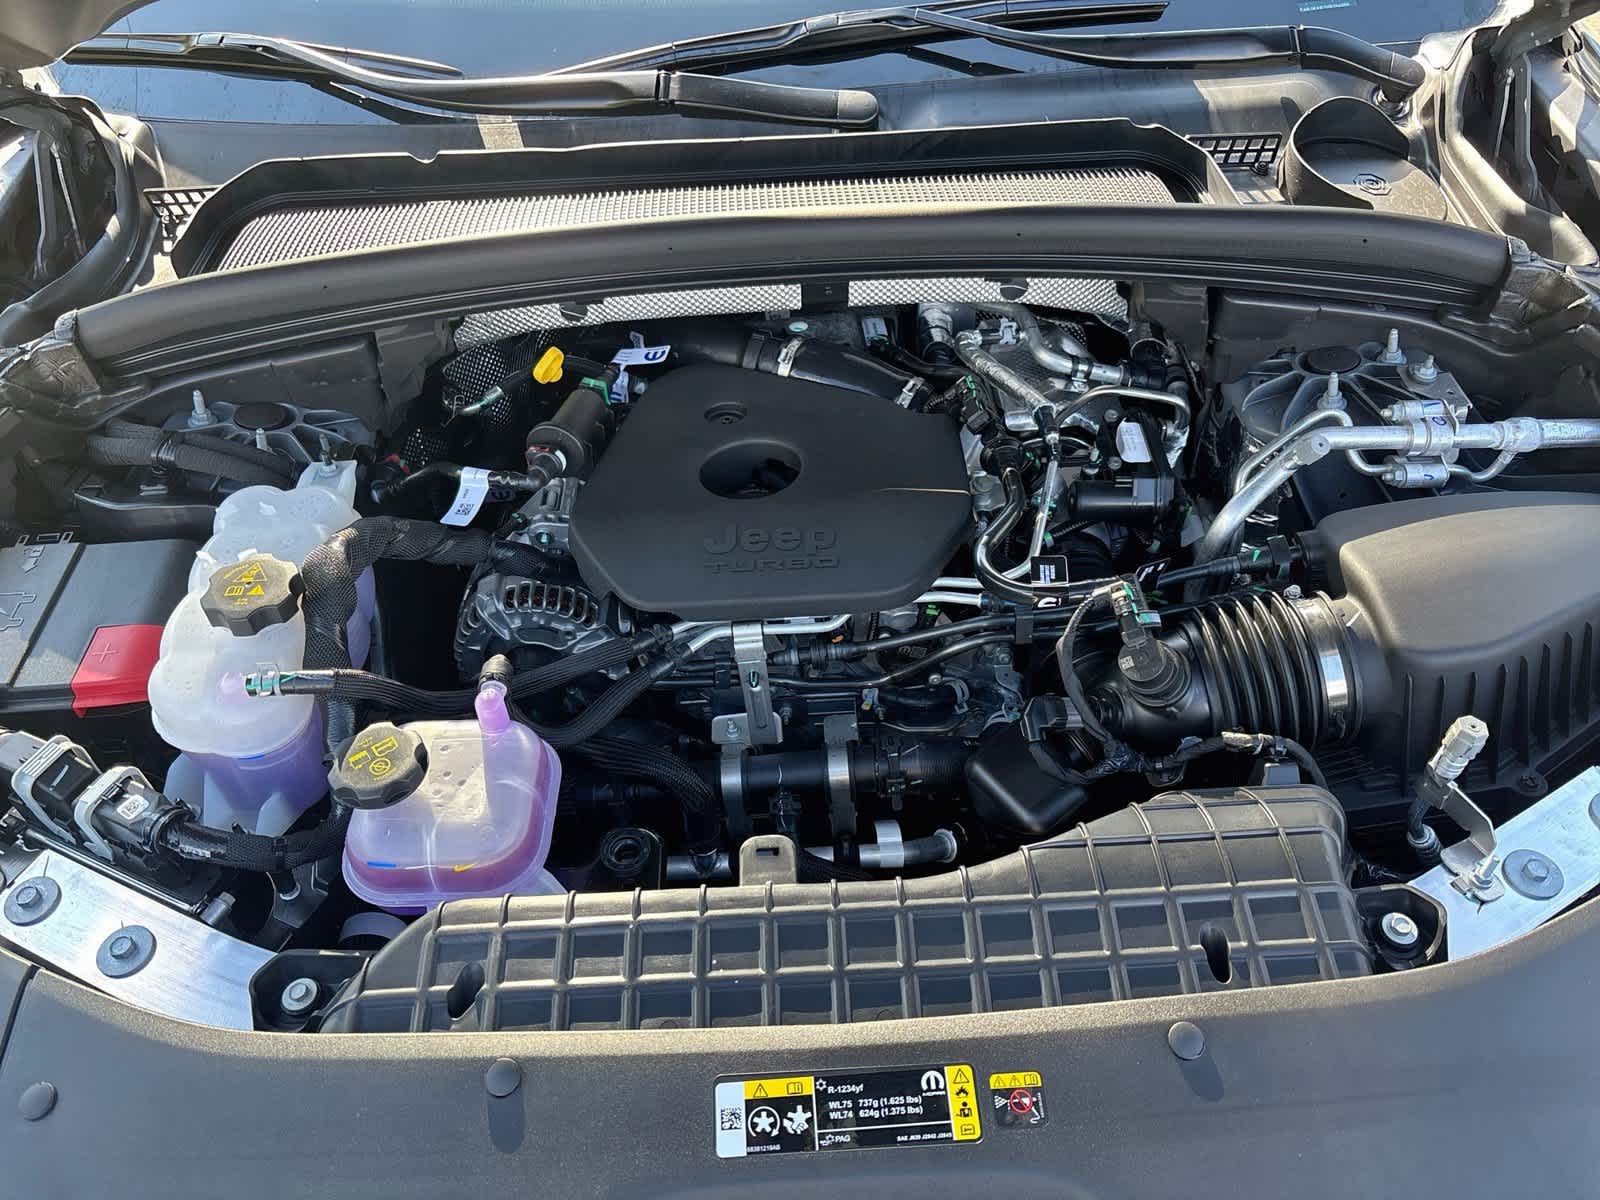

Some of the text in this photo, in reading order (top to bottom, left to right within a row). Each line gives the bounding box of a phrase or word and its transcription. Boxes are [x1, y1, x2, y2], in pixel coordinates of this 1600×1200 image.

[704, 523, 838, 556] Jeep
[703, 555, 840, 574] TURBO
[827, 1083, 864, 1094] R-1234yf
[828, 1095, 922, 1109] WL75 737g (1.625 lbs)
[829, 1105, 923, 1120] WL74 624g (1.375 lbs)
[835, 1134, 851, 1143] PAG
